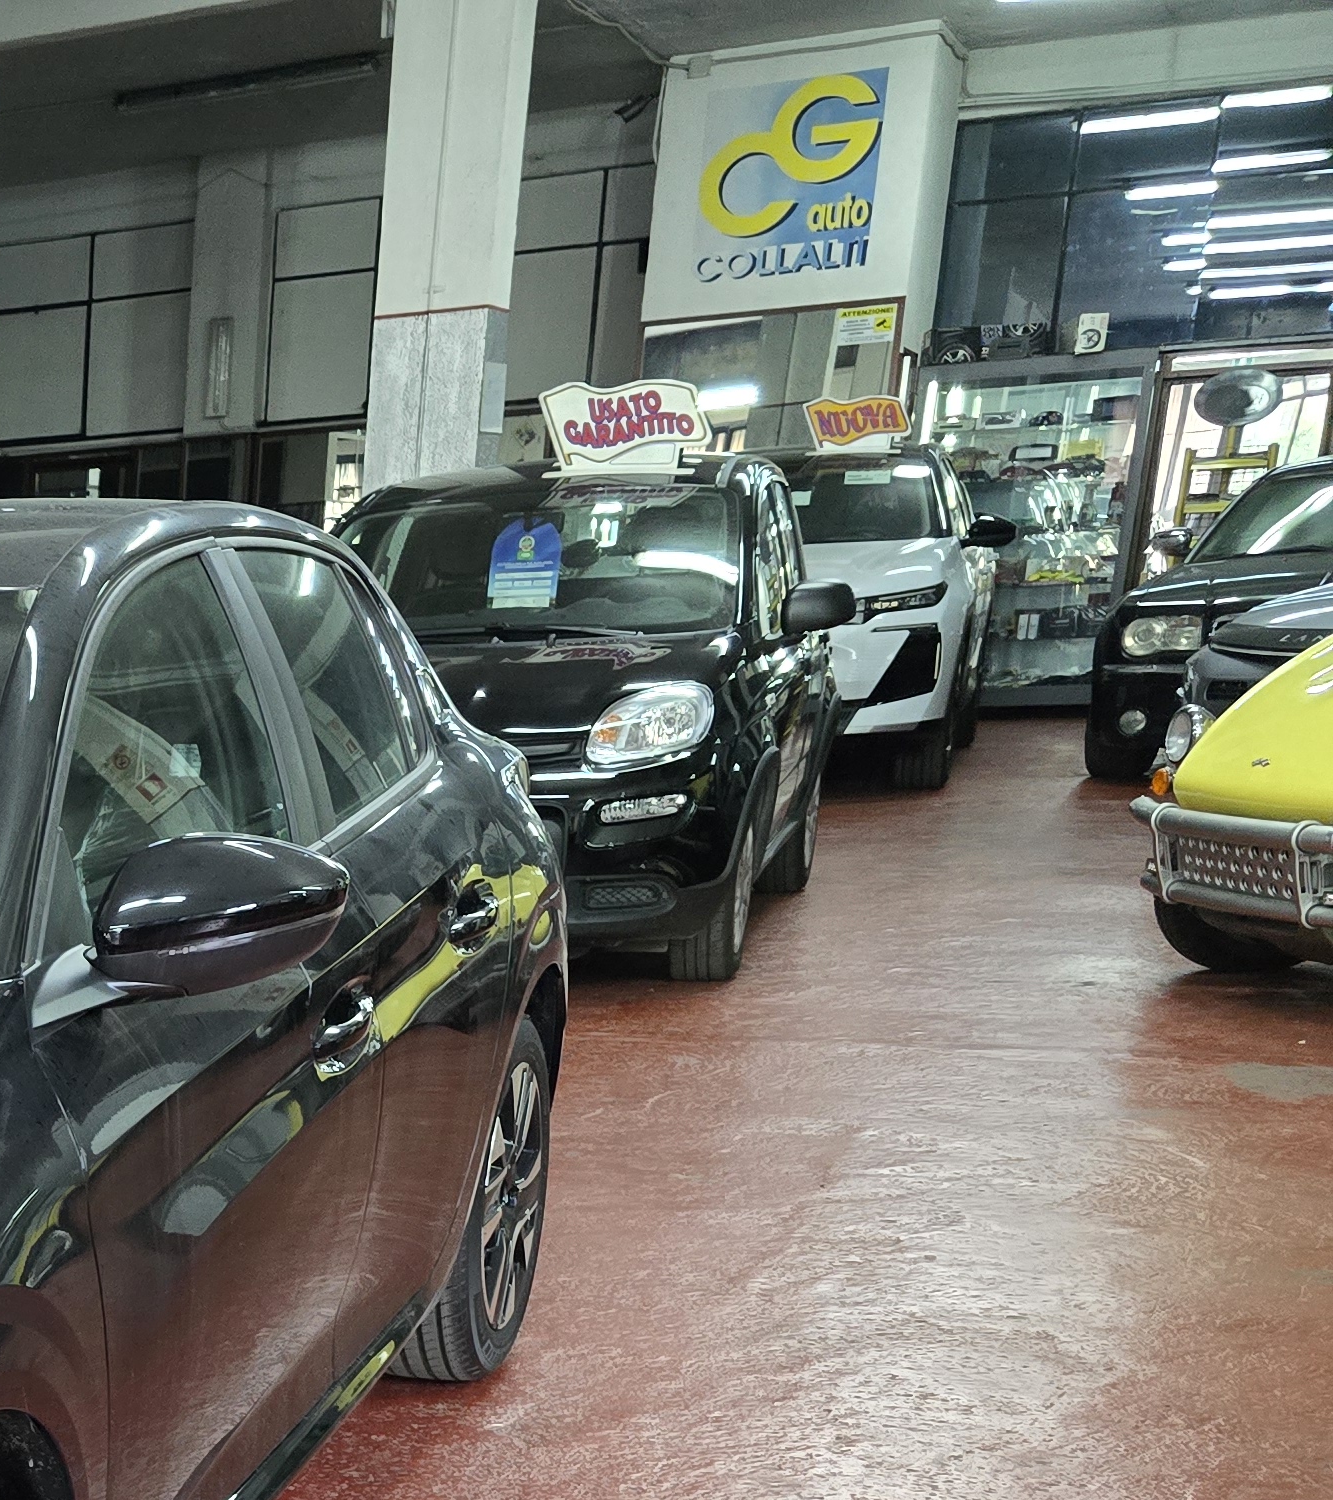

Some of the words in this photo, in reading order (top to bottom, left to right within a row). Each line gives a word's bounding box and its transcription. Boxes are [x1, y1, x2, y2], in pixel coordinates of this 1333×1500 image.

[806, 192, 873, 233] auto
[694, 234, 871, 283] COLLALTI
[587, 390, 662, 424] USATO
[814, 402, 901, 438] NUOVA
[564, 412, 695, 449] GARANTITO
